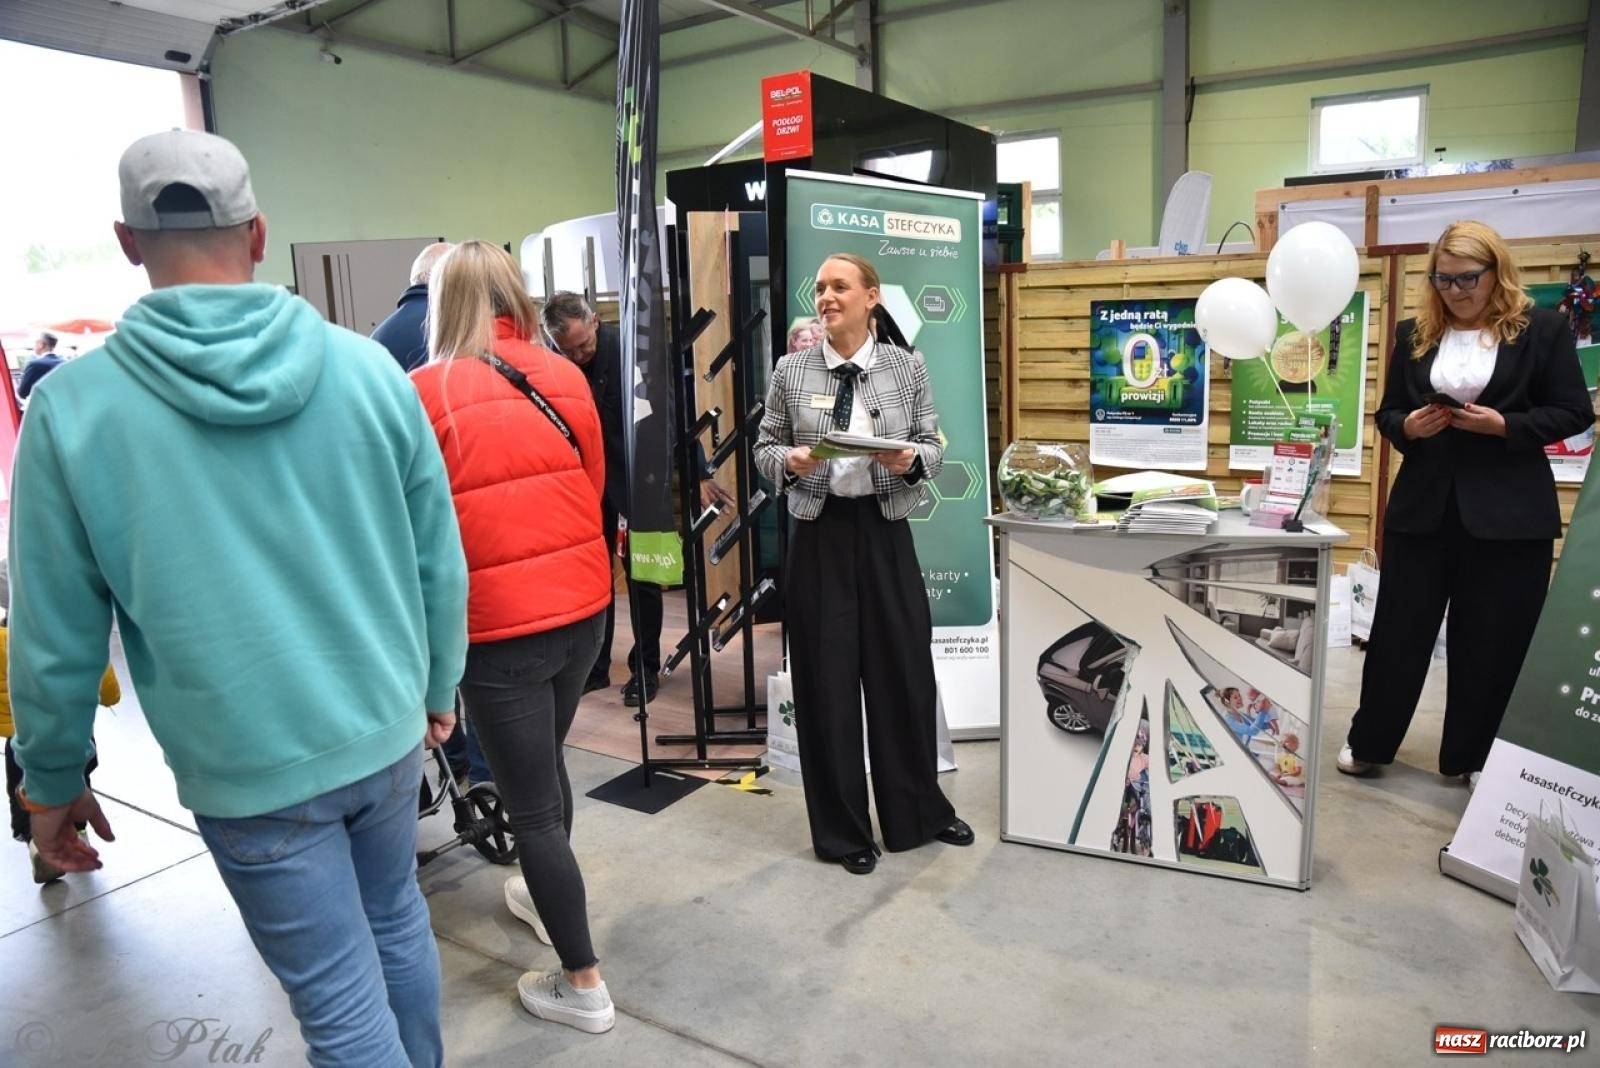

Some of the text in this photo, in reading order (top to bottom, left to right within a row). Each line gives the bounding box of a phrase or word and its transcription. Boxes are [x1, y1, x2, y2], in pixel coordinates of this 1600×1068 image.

[772, 115, 803, 127] PODŁOGI
[776, 124, 800, 136] DRZWI
[837, 211, 956, 236] KASA STEFCZYKA
[878, 239, 960, 259] Zawsze u siebie
[1100, 309, 1168, 323] Z jedną ratą
[1121, 391, 1165, 403] prowizji
[929, 569, 961, 583] karty
[931, 636, 988, 645] asastefczyka.pl
[975, 646, 989, 654] 100
[1575, 706, 1590, 719] do
